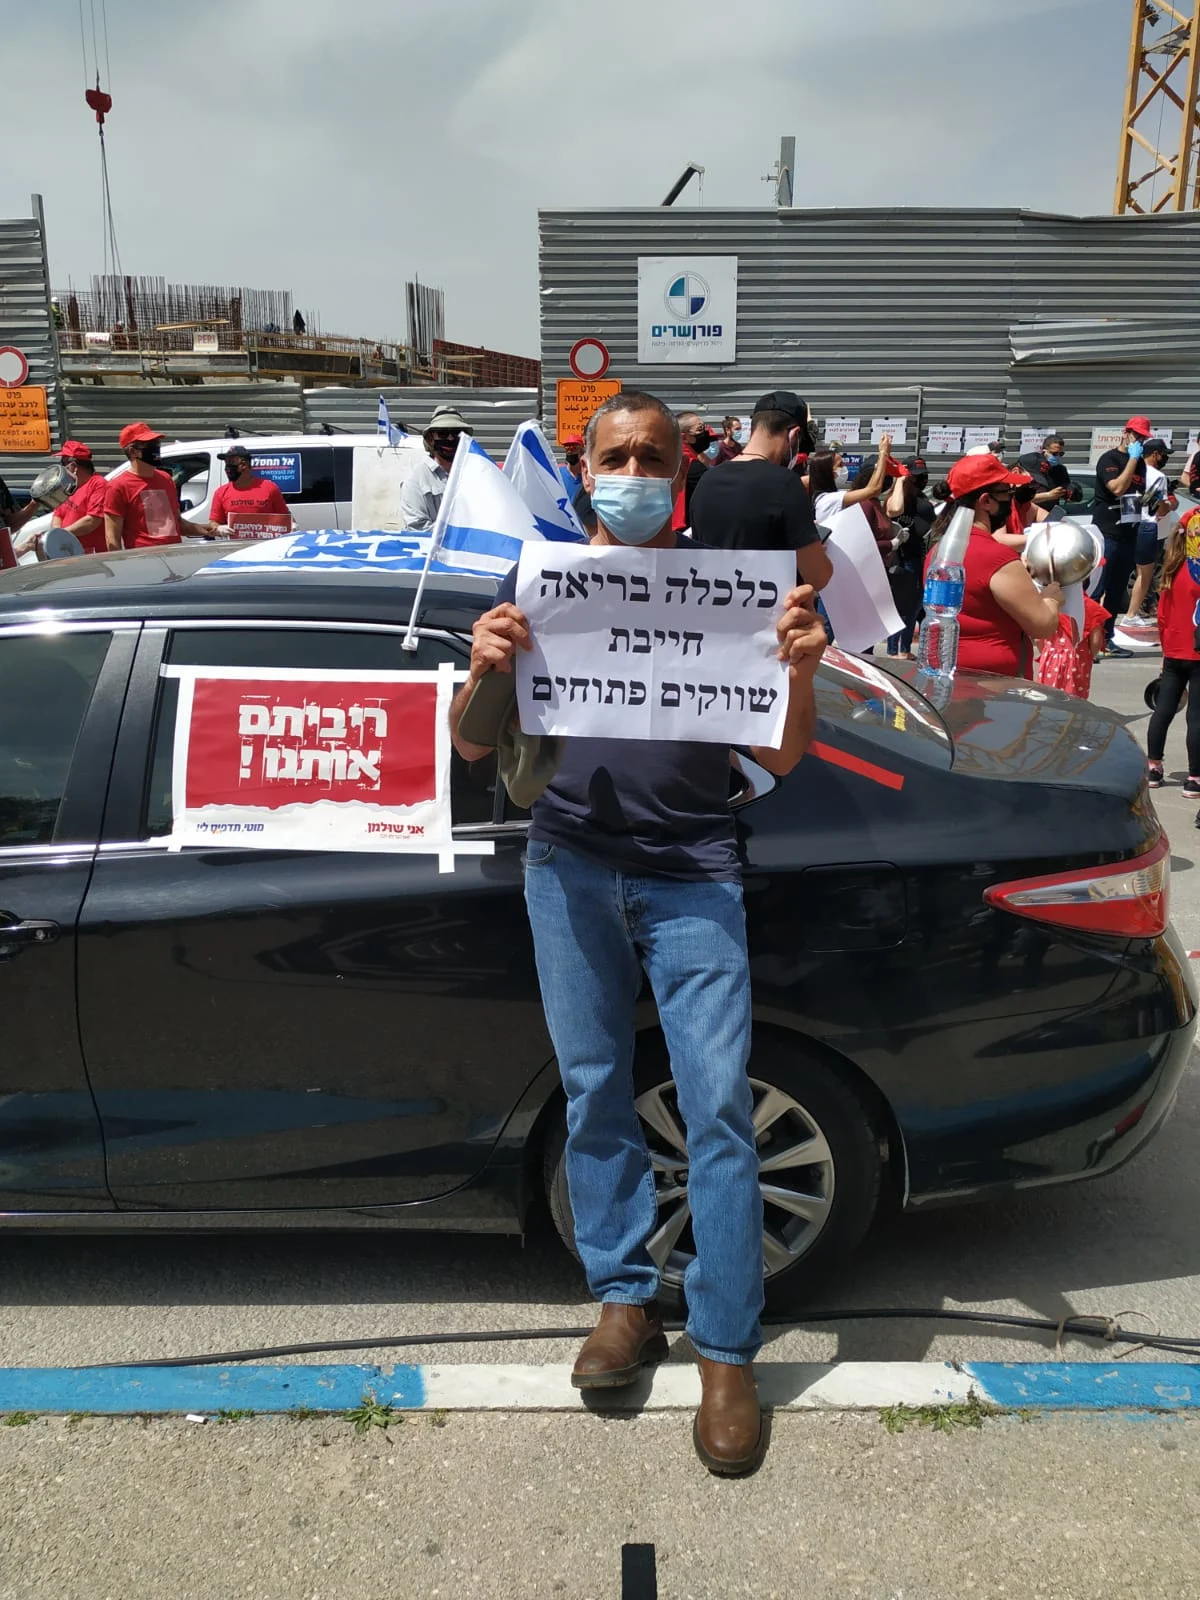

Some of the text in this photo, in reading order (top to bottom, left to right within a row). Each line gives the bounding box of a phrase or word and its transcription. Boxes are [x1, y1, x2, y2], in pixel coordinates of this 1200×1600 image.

[282, 457, 295, 466] אל
[540, 567, 778, 608] כלכלה בריאה
[608, 627, 704, 656] חייבת
[532, 675, 778, 716] שווקים פתוחים
[211, 823, 241, 833] תדפיס
[407, 824, 424, 834] אני
